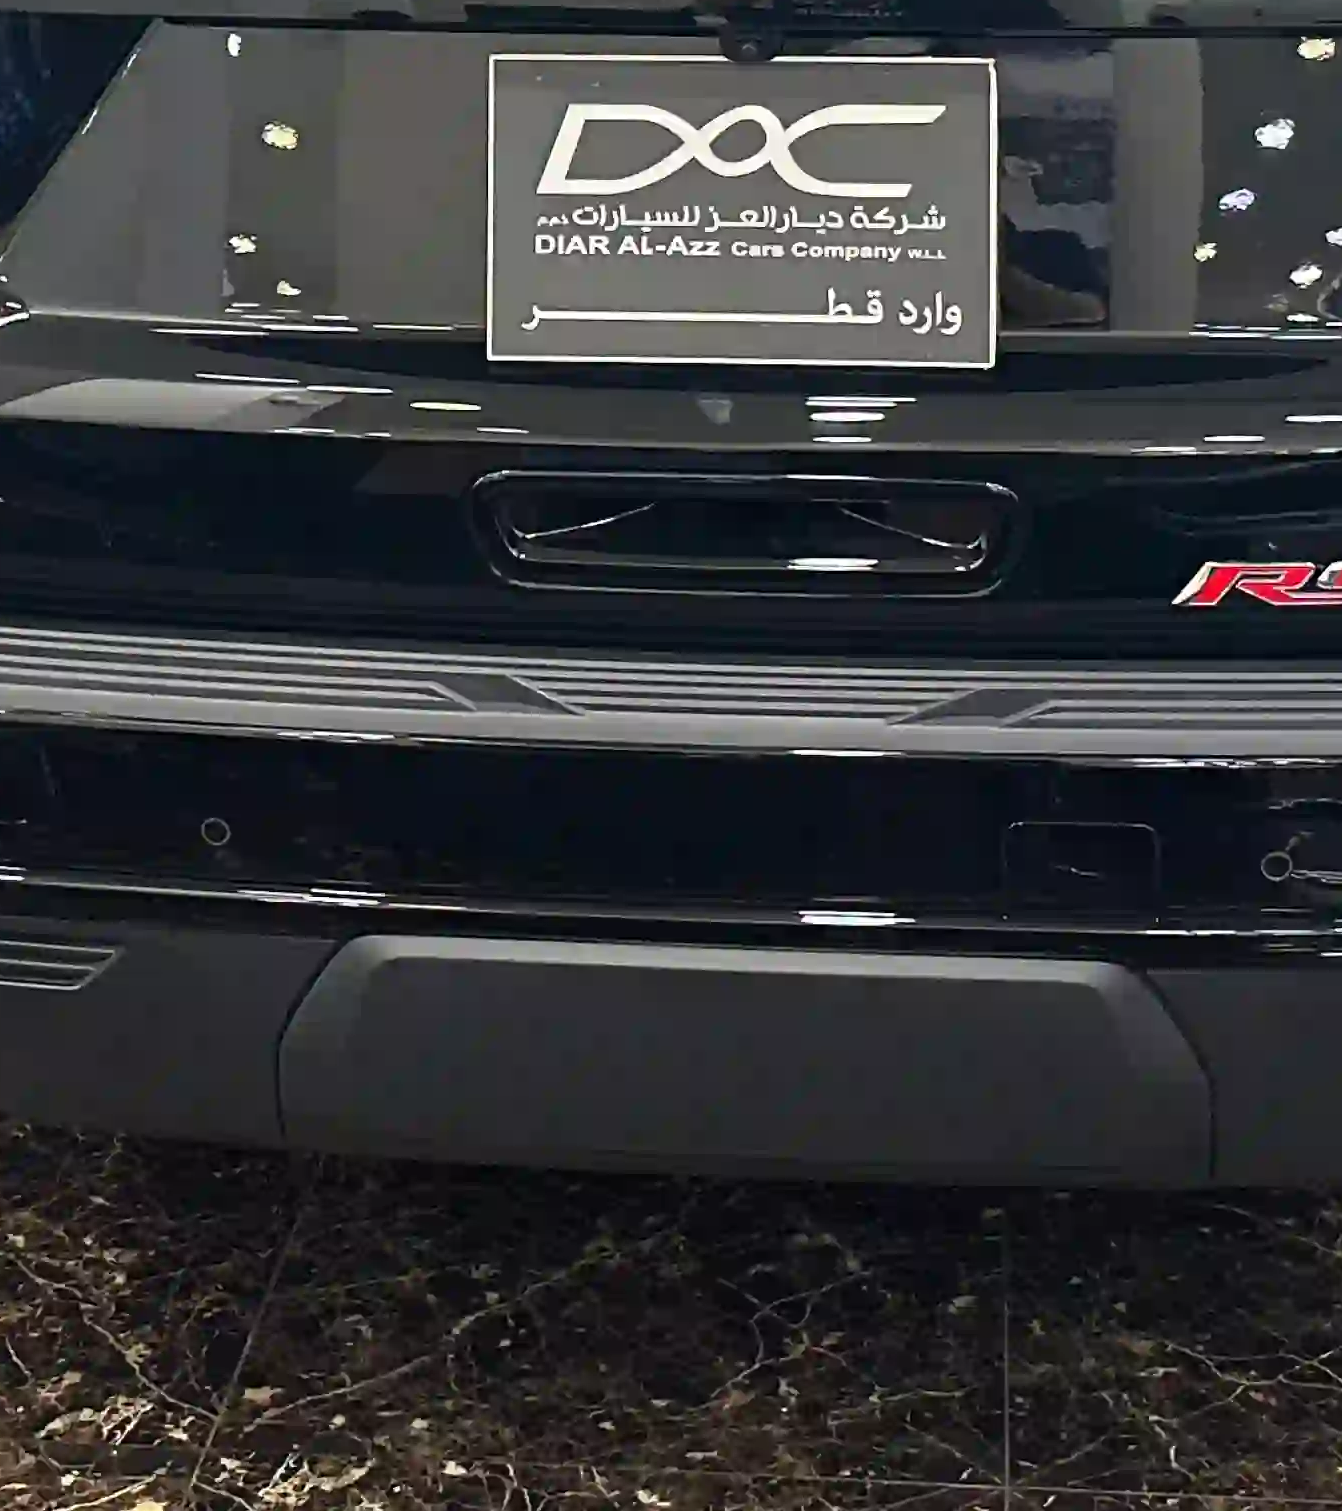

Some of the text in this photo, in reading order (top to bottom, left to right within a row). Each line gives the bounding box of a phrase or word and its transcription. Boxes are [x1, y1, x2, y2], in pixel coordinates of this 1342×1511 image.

[571, 203, 700, 233] للسيارات
[850, 203, 947, 235] شركة
[534, 233, 611, 256] DIAR
[730, 240, 785, 258] Cars
[790, 240, 902, 263] Company
[898, 290, 963, 335] وارد
